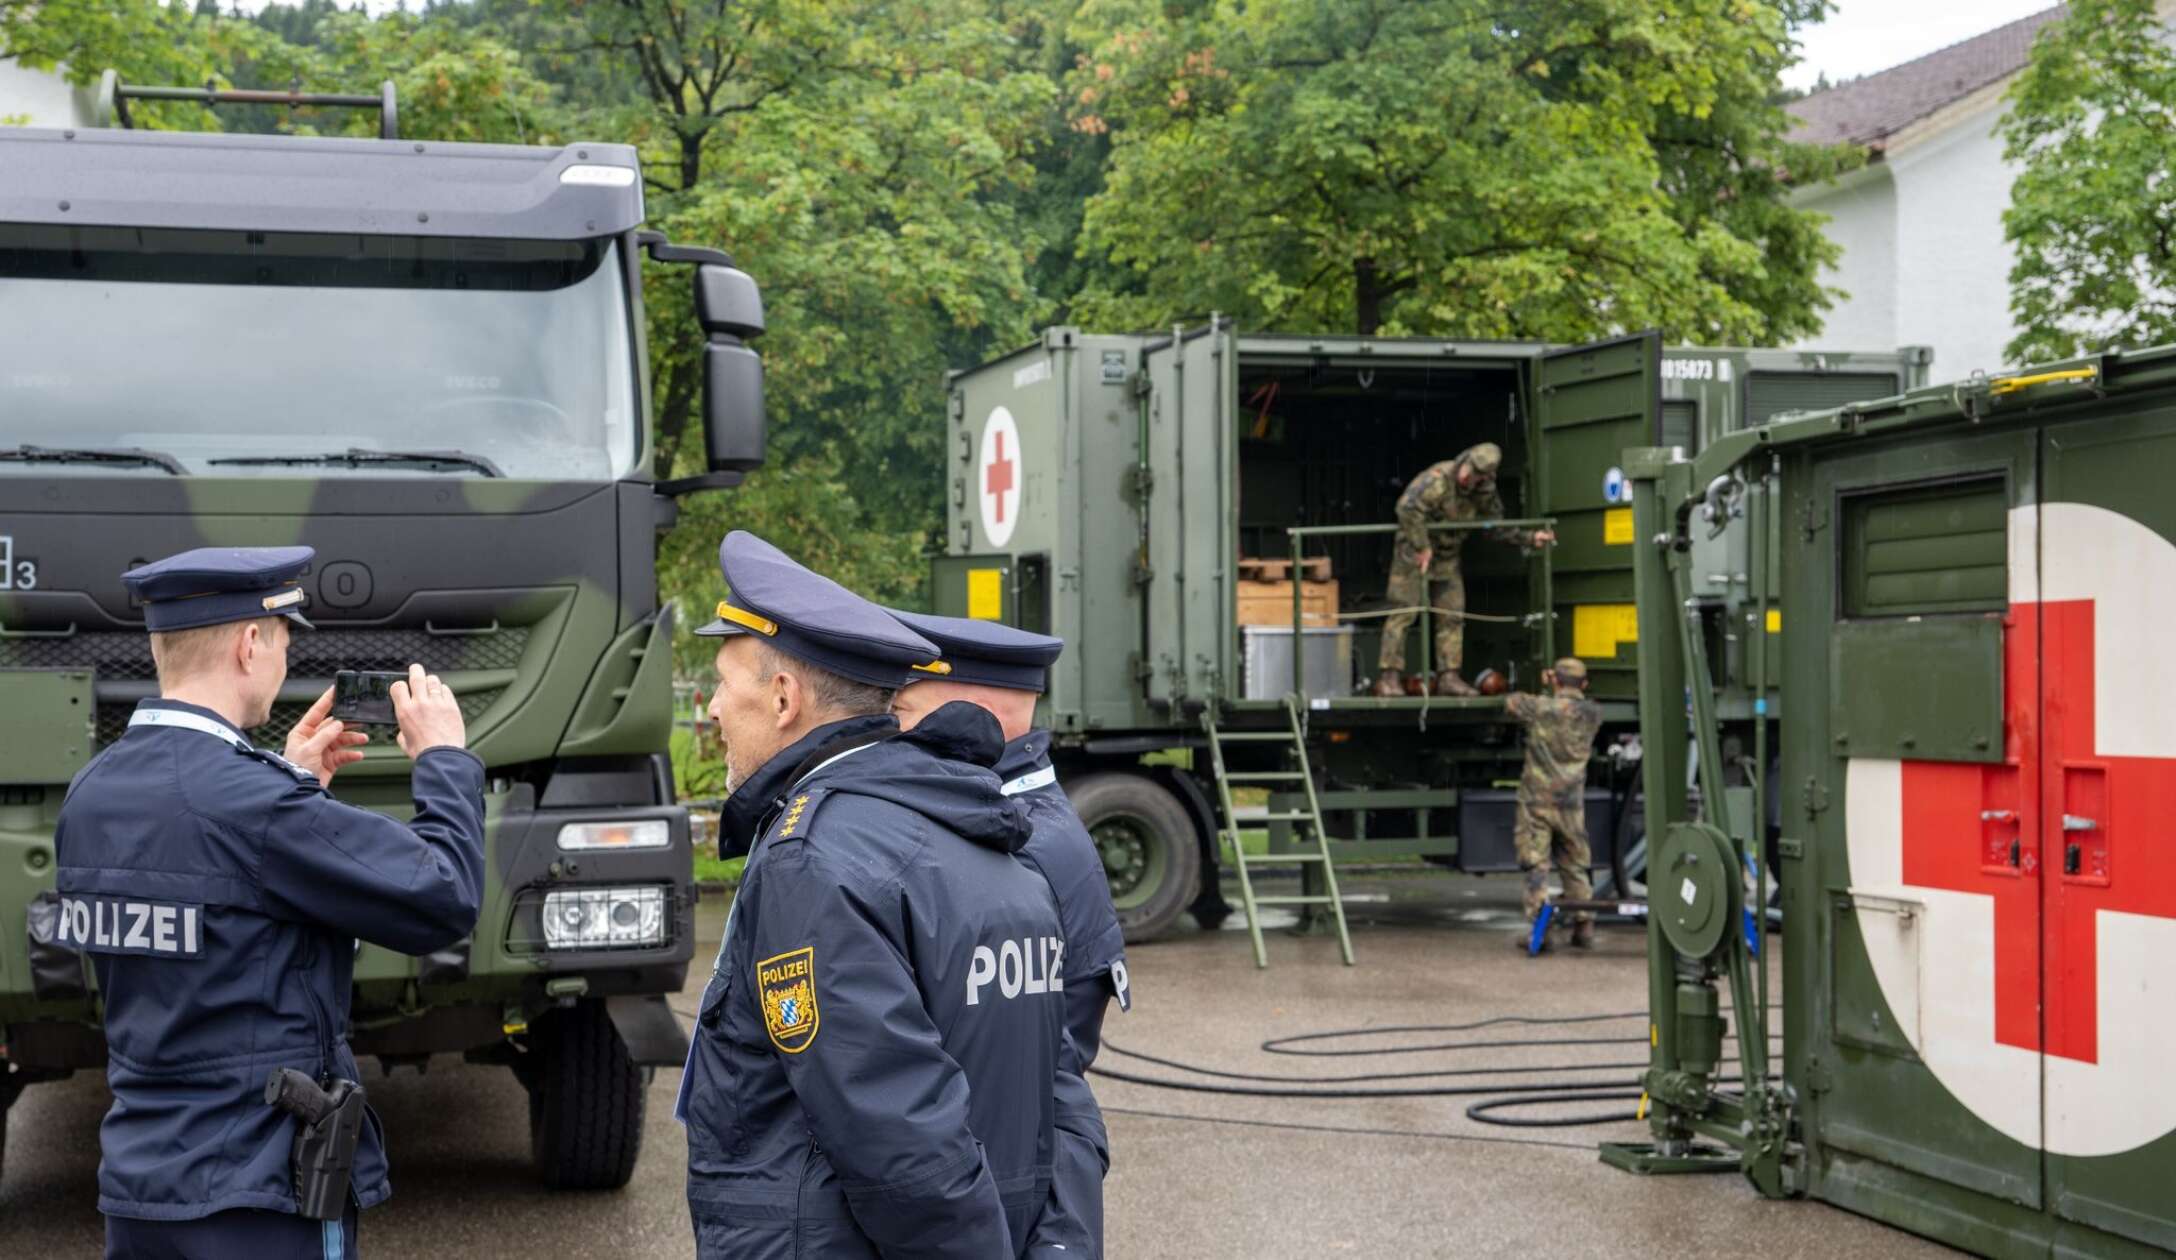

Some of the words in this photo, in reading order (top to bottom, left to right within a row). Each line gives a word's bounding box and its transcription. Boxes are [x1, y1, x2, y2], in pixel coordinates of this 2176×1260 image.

[17, 561, 37, 590] 3
[58, 898, 197, 953] POLIZEI
[762, 959, 808, 986] POLIZEI
